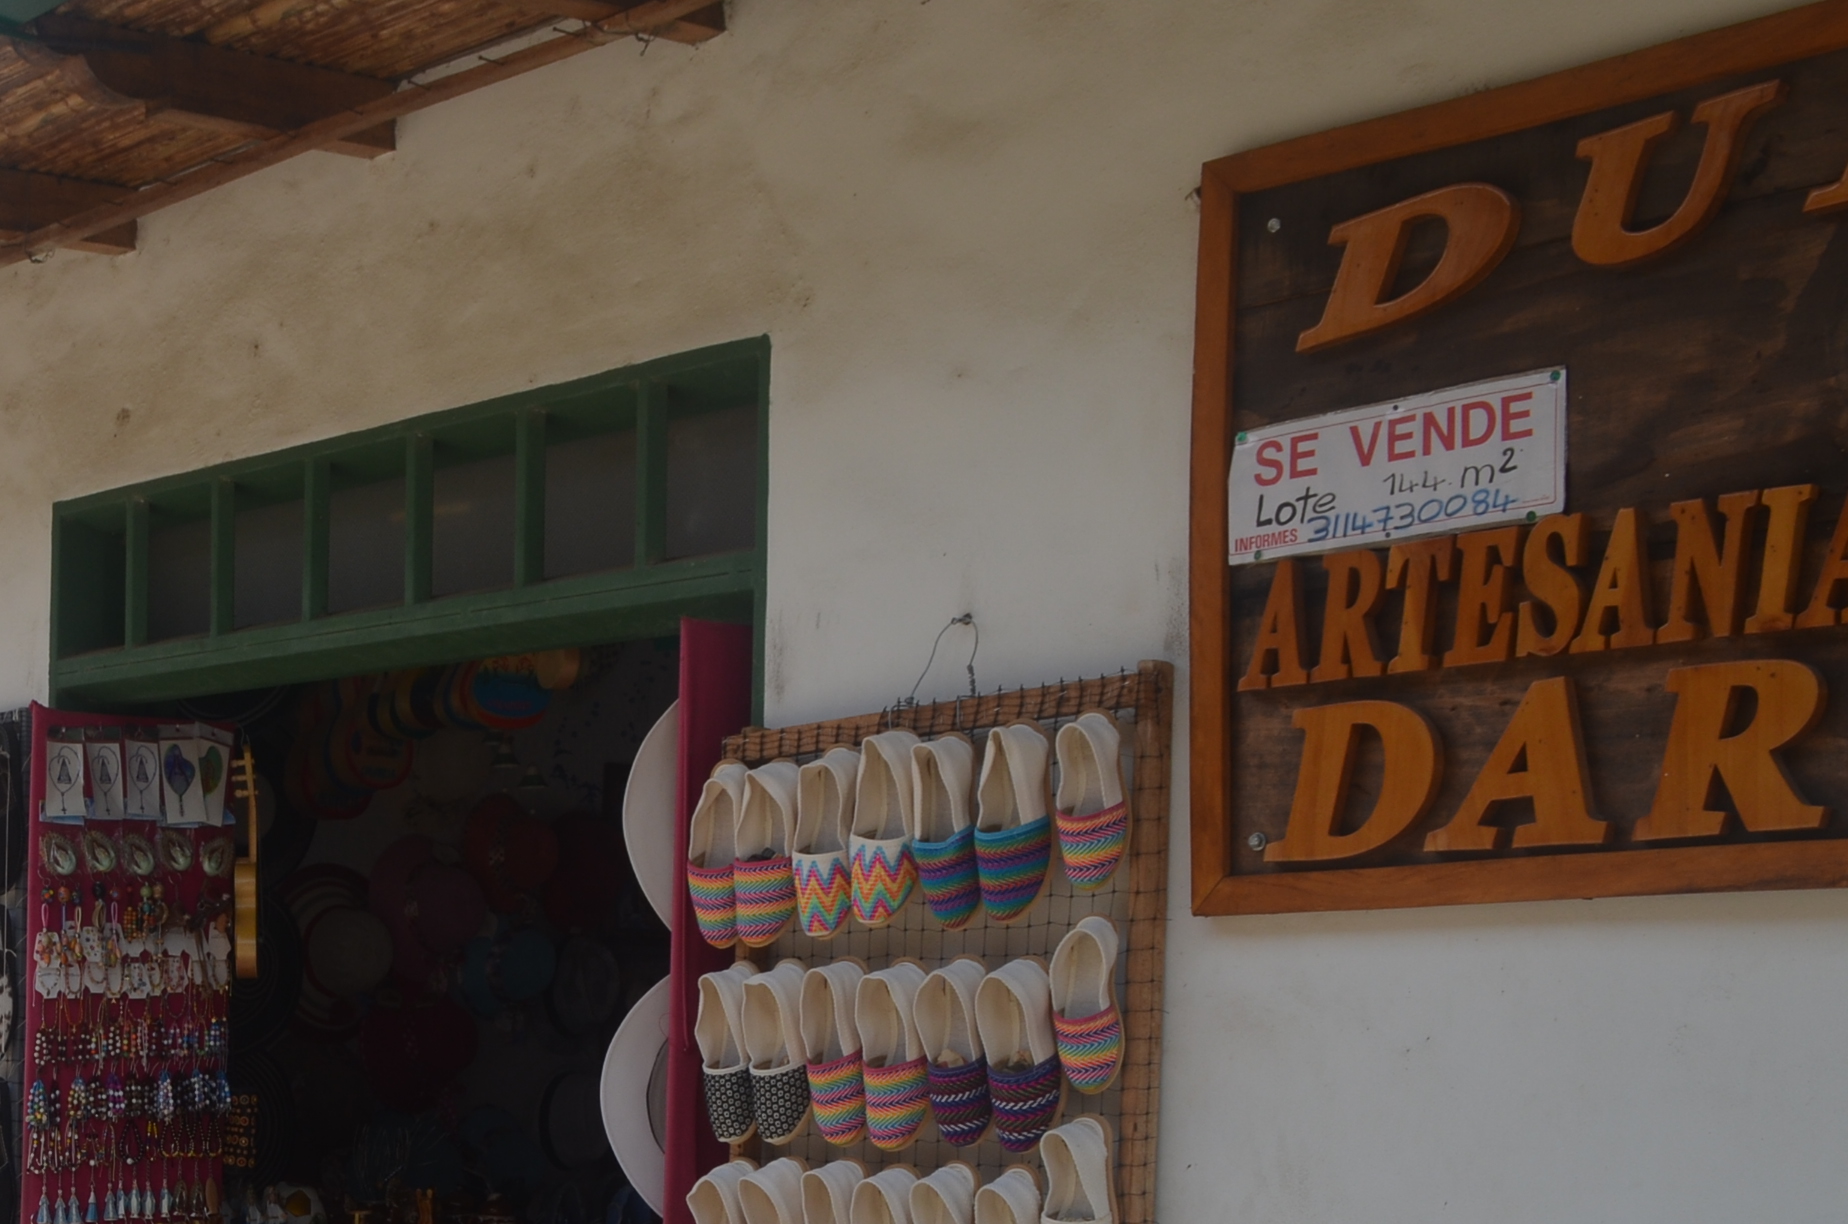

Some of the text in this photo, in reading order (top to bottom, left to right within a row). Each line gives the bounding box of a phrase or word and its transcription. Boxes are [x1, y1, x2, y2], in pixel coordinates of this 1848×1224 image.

[1295, 78, 1848, 353] DU
[1253, 391, 1535, 487] SE VENDE
[1234, 487, 1520, 554] INFORMES 3114730084
[1255, 486, 1337, 528] Lote
